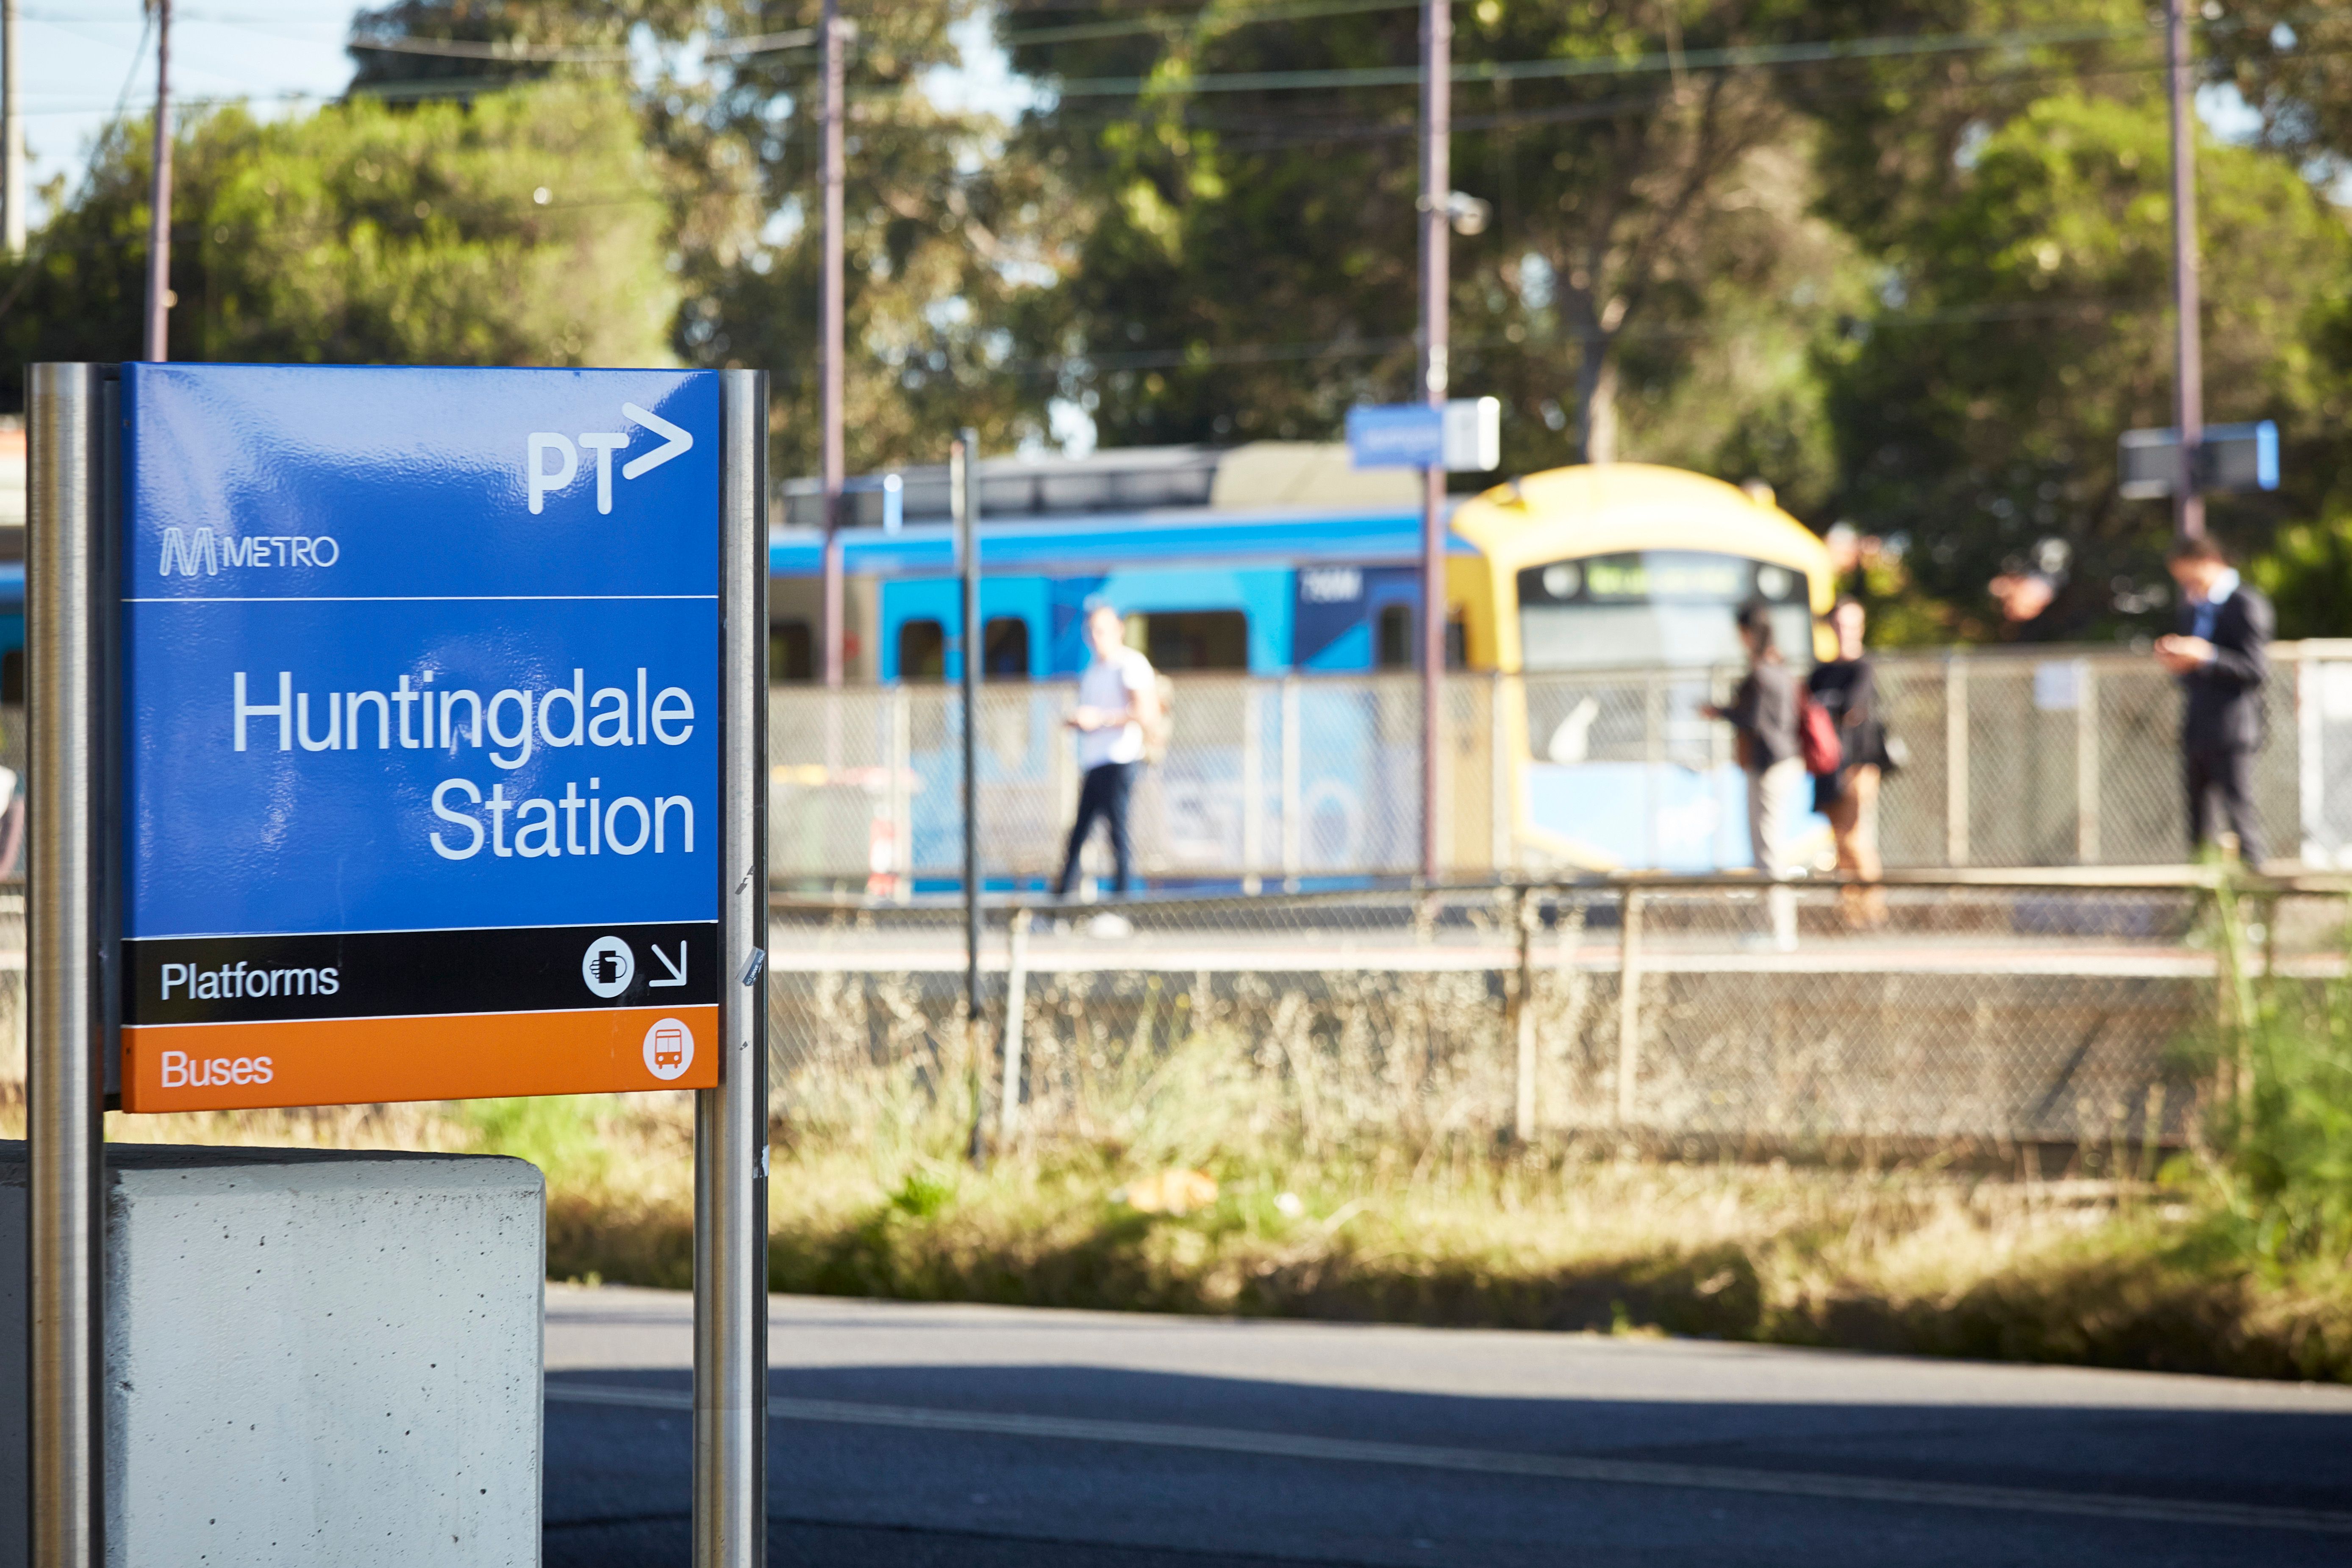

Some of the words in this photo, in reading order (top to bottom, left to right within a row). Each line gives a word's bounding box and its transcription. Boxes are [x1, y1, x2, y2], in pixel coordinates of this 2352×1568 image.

[223, 536, 339, 567] METRO
[234, 667, 694, 769] Huntingdale
[430, 778, 693, 860] Station
[161, 961, 339, 1001] Platforms
[161, 1051, 274, 1088] Buses
